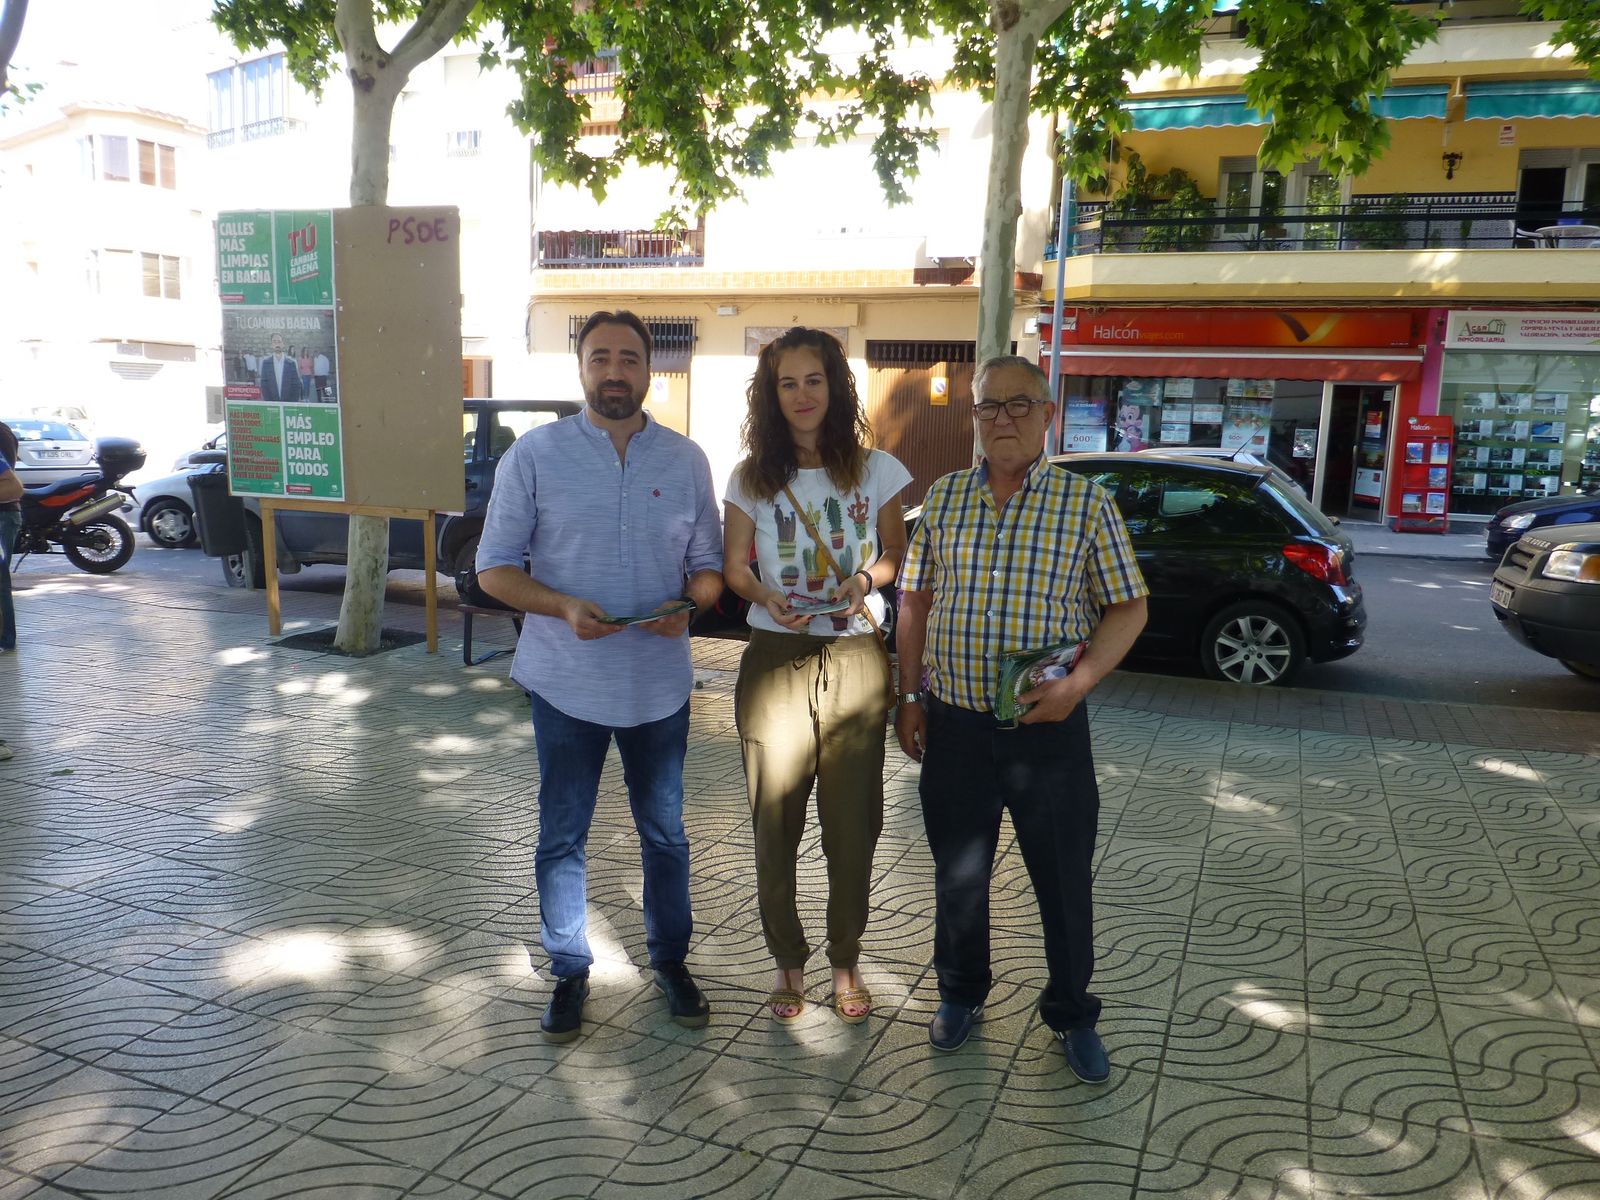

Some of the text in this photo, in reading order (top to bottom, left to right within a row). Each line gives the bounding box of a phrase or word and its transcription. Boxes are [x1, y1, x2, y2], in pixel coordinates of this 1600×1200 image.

[219, 222, 255, 236] CALLES
[387, 216, 450, 245] PSOE
[220, 236, 246, 252] MÁS
[287, 221, 318, 257] TÚ
[220, 254, 269, 268] LIMPIAS
[290, 251, 319, 268] CAMBIAS
[290, 260, 320, 278] BAENA
[221, 270, 272, 284] EN BAENA
[247, 316, 285, 329] CAMBIAS
[286, 316, 321, 330] BAENA
[286, 413, 312, 430] MÁS
[286, 431, 335, 446] EMPLEO
[1073, 433, 1093, 443] 600
[287, 447, 321, 461] PARA
[288, 462, 329, 477] TODOS
